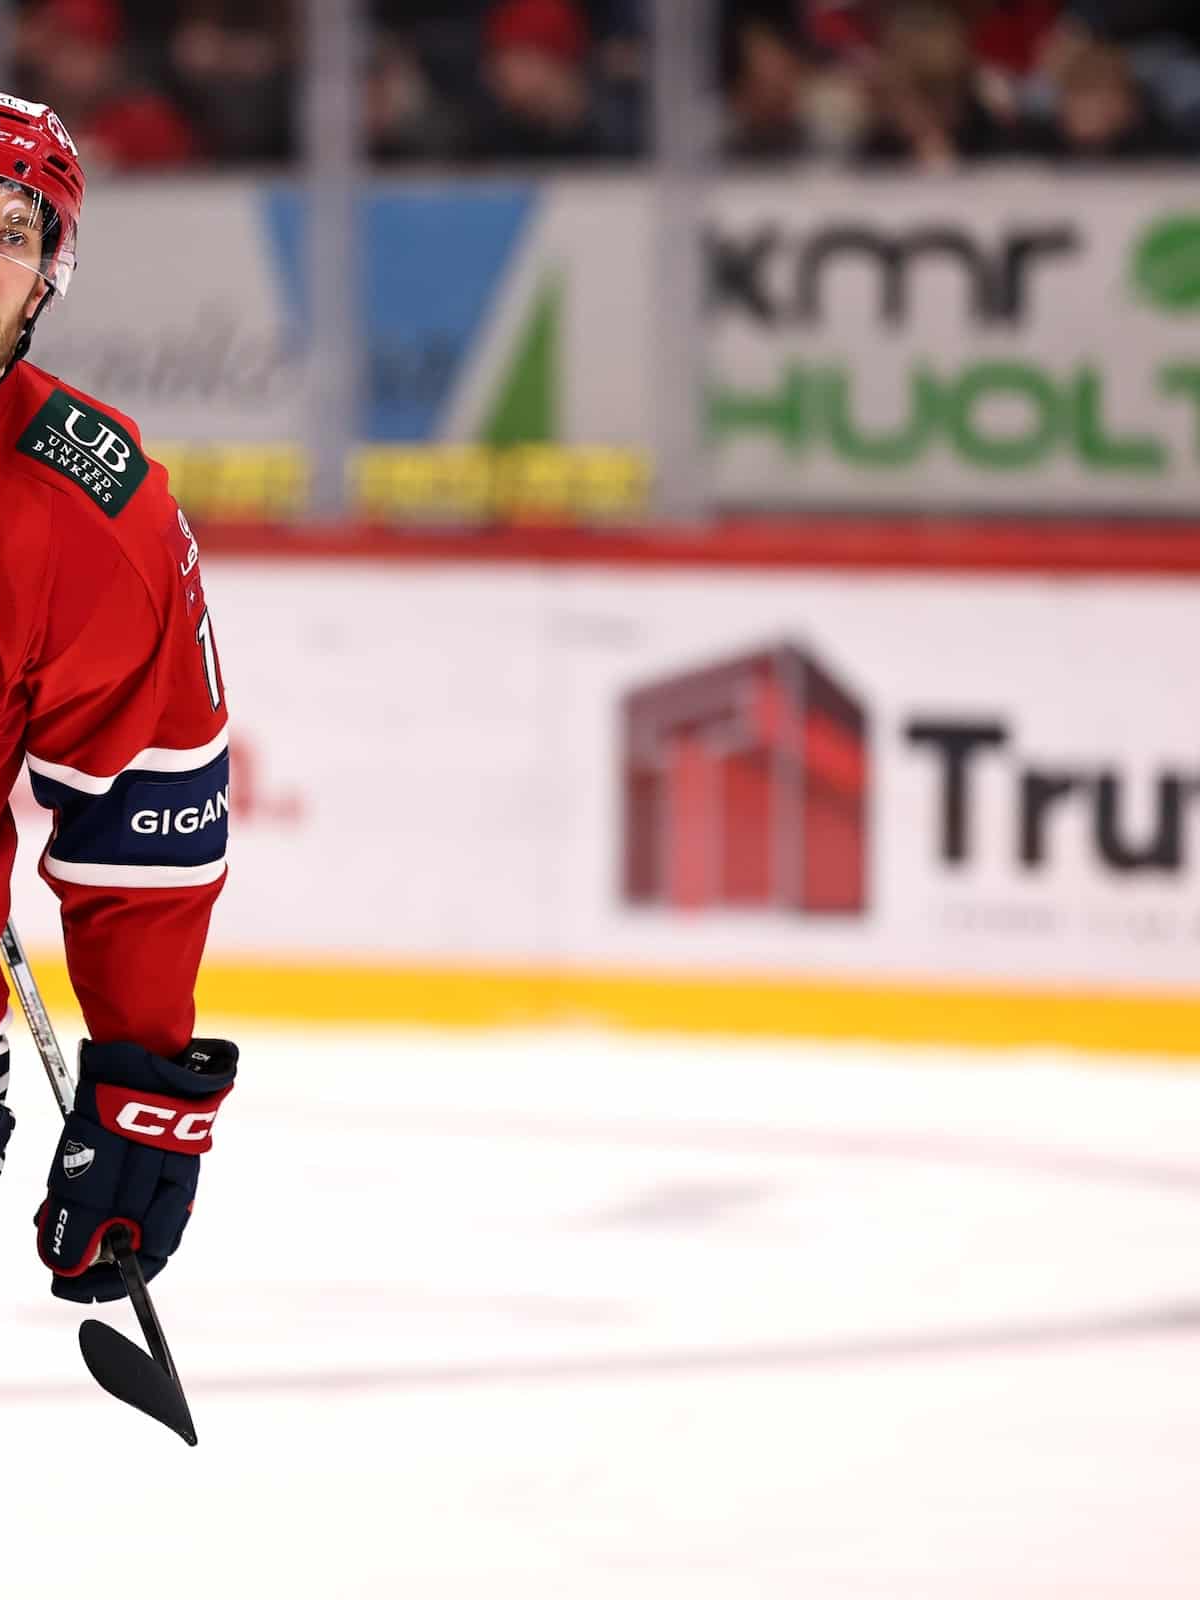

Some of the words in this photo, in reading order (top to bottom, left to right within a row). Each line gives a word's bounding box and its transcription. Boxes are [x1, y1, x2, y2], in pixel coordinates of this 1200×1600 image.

[47, 434, 112, 488] UNITED
[64, 404, 131, 473] UB
[31, 439, 113, 503] BANKERS
[903, 722, 1200, 872] Tru
[116, 1101, 216, 1141] CC
[53, 1208, 68, 1256] CCM
